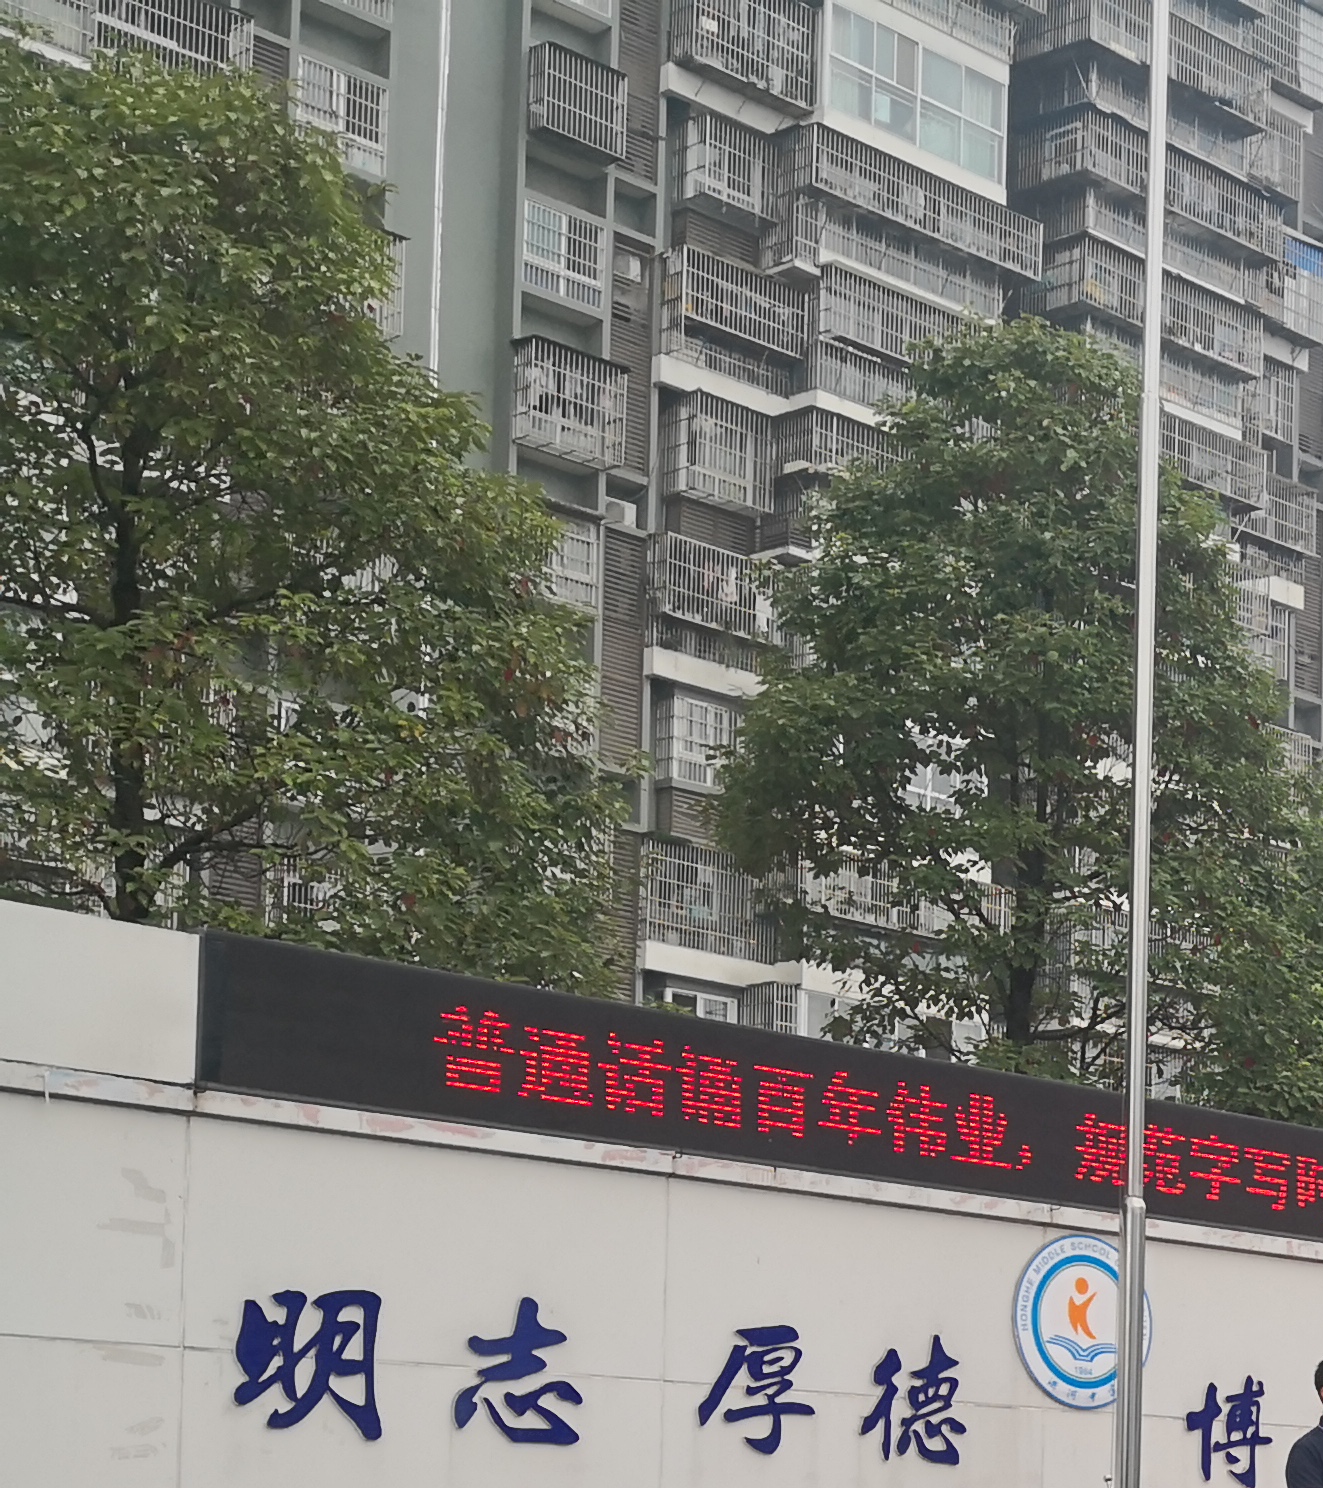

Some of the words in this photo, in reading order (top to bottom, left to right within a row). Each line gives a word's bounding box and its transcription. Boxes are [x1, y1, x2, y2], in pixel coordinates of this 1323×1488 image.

[1020, 1278, 1034, 1331] HONGHE
[1033, 1244, 1066, 1275] MIDDLE
[1070, 1241, 1110, 1259] SCHOOL
[233, 1289, 583, 1447] 明志
[698, 1325, 967, 1467] 厚德
